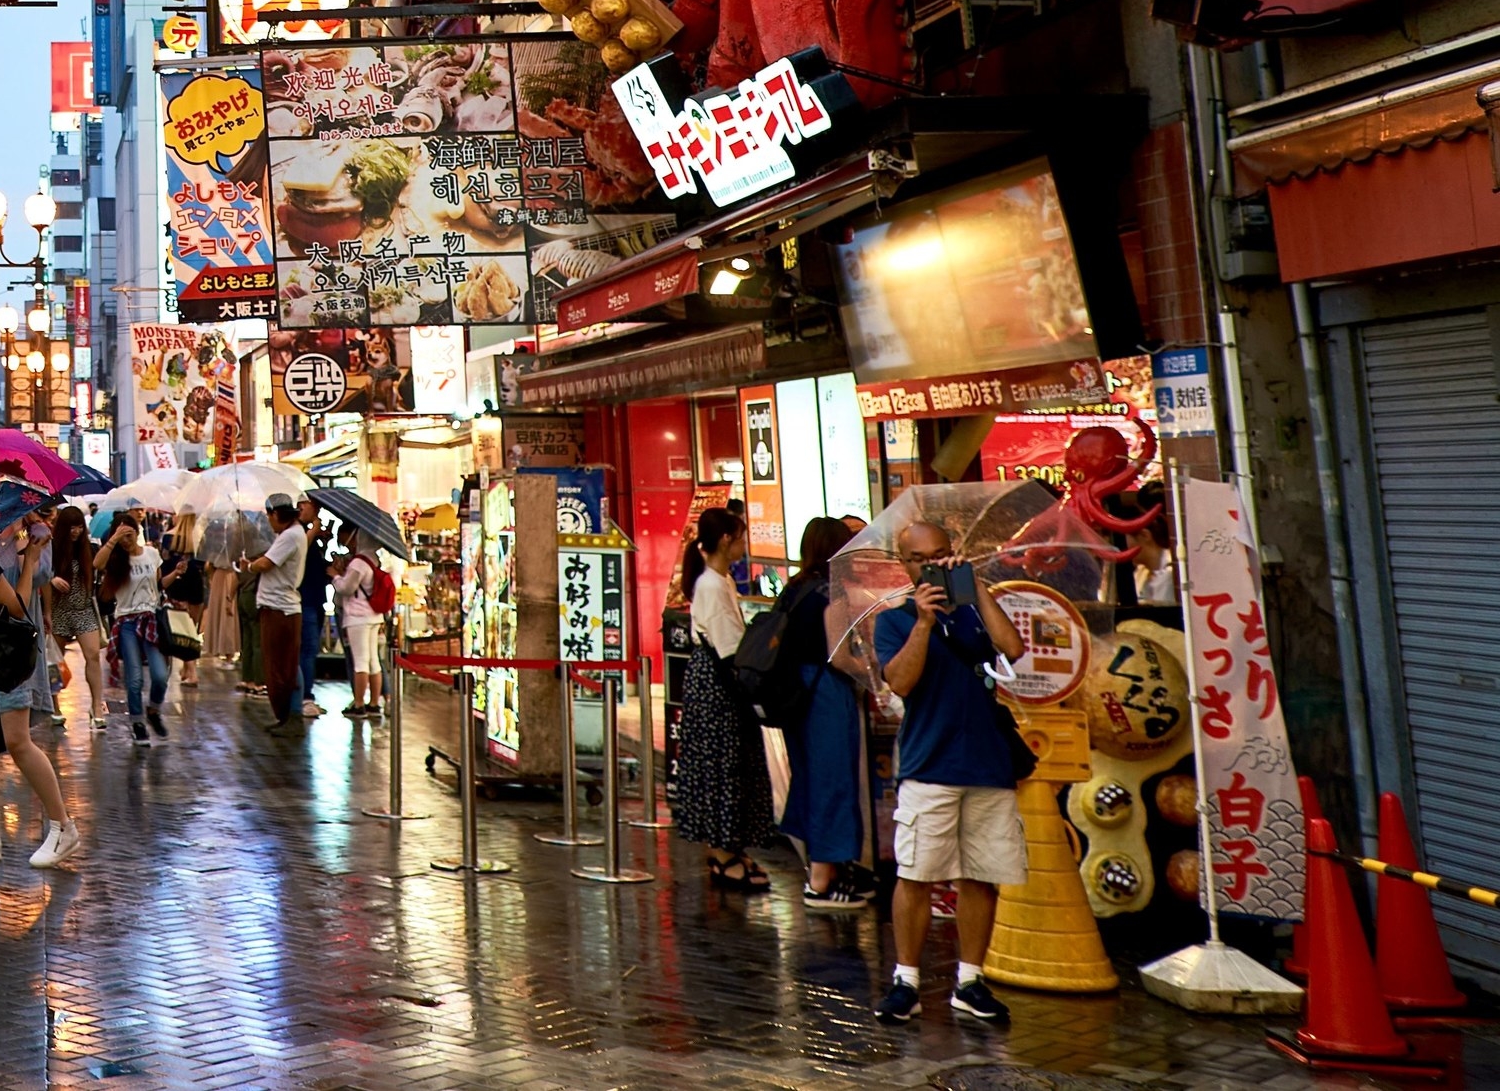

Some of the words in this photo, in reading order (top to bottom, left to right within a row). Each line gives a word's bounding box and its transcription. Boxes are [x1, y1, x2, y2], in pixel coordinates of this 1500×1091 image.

[284, 63, 392, 96] 欢迎光临
[174, 88, 250, 140] おみやげ
[293, 94, 398, 122] 어서오세요
[320, 123, 402, 141] いらっしゃいませ
[174, 181, 258, 204] よしもと
[430, 171, 585, 205] 해선호프집
[176, 205, 260, 231] エンタメ
[498, 209, 588, 225] 海鮮居酒屋
[176, 232, 262, 258] ショップ
[306, 231, 467, 267] 大阪名产物
[312, 260, 470, 294] 오오사까특산품
[313, 297, 366, 313] 大阪名物
[133, 327, 197, 341] MONSTER
[288, 361, 343, 403] 豆柴
[929, 378, 1002, 410] 自由席あります
[1011, 382, 1026, 402] Eat
[1027, 381, 1036, 400] in
[1175, 386, 1207, 408] 支付宝
[139, 428, 156, 441] 2F
[515, 429, 578, 445] 豆柴カフェ
[563, 553, 594, 662] お好み焼
[1191, 592, 1235, 740] てっさ
[1212, 772, 1269, 901] 白子
